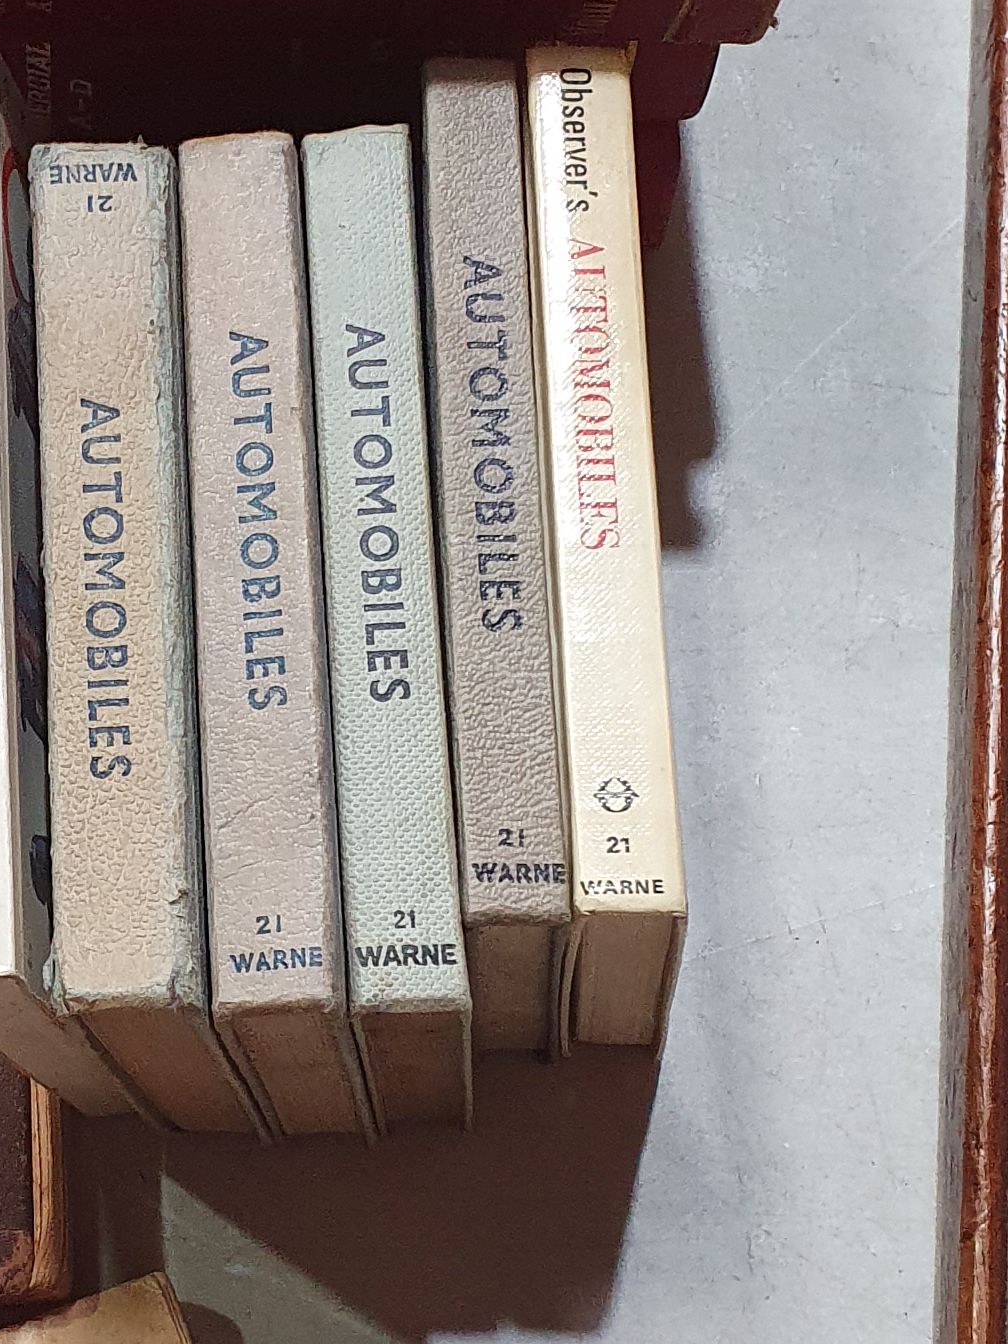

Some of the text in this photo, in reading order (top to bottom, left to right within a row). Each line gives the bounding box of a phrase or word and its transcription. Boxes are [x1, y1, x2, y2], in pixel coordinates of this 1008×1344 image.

[49, 162, 138, 184] WARNE
[87, 195, 113, 213] 21
[559, 67, 621, 550] Observer's AUTOMOBILES
[463, 256, 524, 633] AUTOMOBILES
[229, 331, 287, 711] AUTOMOBILES
[345, 324, 411, 703] AUTOMOBILES
[80, 398, 132, 780] AUTOMOBILES
[498, 829, 524, 848] 21
[606, 836, 631, 854] 21
[472, 863, 566, 885] WARNE
[580, 879, 665, 896] WARNE
[255, 916, 283, 935] 21
[393, 910, 416, 930] 21
[230, 947, 323, 974] WARNE
[355, 944, 458, 967] WARNE
